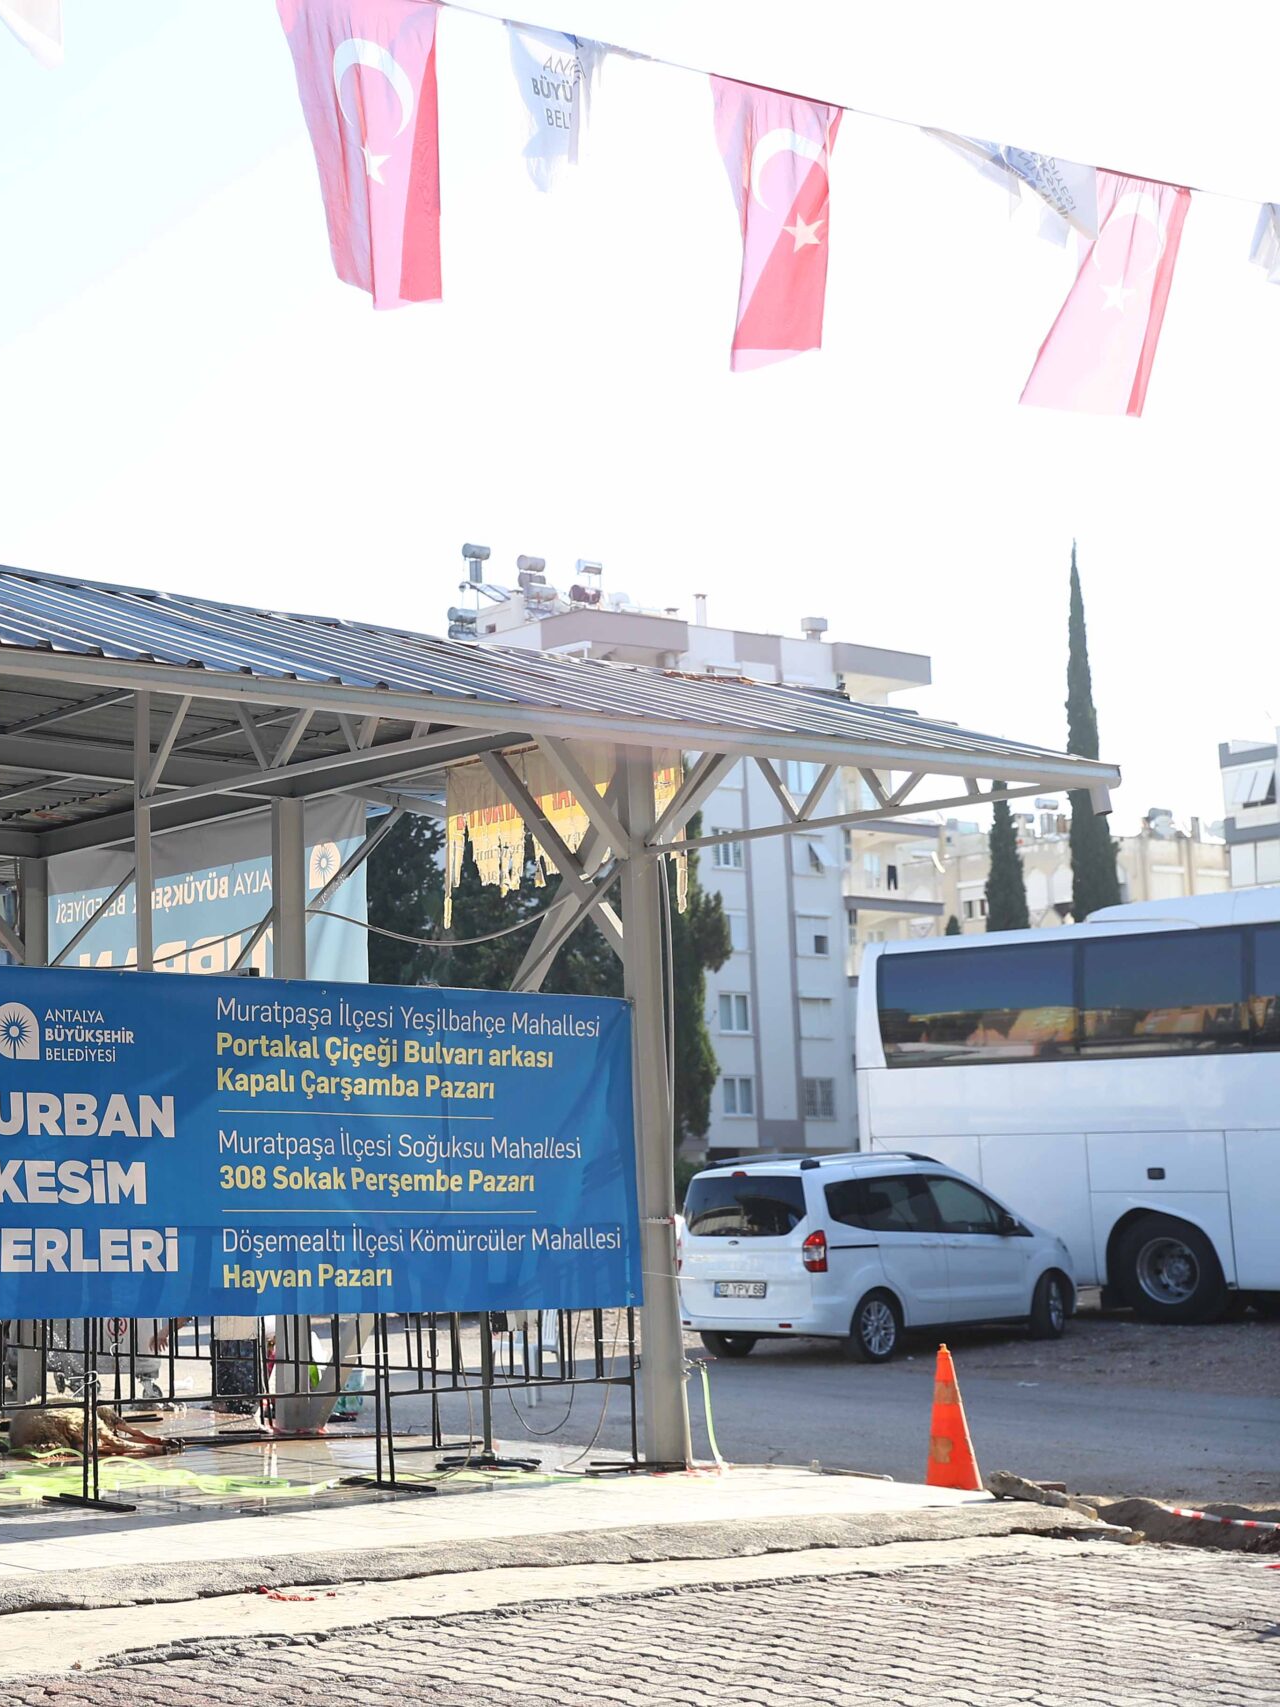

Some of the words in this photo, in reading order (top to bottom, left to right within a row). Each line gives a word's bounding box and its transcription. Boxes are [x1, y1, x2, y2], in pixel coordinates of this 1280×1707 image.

[44, 1008, 105, 1024] ANTALYA
[216, 997, 333, 1031] Muratpaşa
[339, 997, 393, 1033] İlçesi
[400, 1005, 506, 1039] Yeşilbahçe
[511, 1011, 600, 1038] Mahallesi
[44, 1025, 135, 1045] BÜYÜKŞEHİR
[216, 1032, 320, 1060] Portakal
[324, 1035, 398, 1067] Çiçeği
[404, 1040, 483, 1066] Bulvarı
[488, 1045, 554, 1069] arkası
[44, 1046, 117, 1063] BELEDİYESİ
[217, 1067, 296, 1097] Kapalı
[301, 1069, 419, 1101] Çarşamba
[425, 1074, 495, 1100] Pazarı
[218, 1129, 336, 1162] Muratpaşa
[340, 1127, 392, 1163] İlçesi
[398, 1133, 486, 1164] Soğuksu
[491, 1135, 582, 1160] Mahallesi
[219, 1164, 267, 1190] 308
[272, 1165, 347, 1190] Sokak
[350, 1166, 463, 1198] Perşembe
[468, 1169, 535, 1193] Pazarı
[222, 1228, 345, 1259] Döşemealtı
[352, 1222, 405, 1258] İlçesi
[410, 1228, 526, 1252] Kömürcüler
[531, 1226, 621, 1251] Mahallesi
[222, 1263, 312, 1294] Hayvan
[318, 1263, 393, 1288] Pazarı
